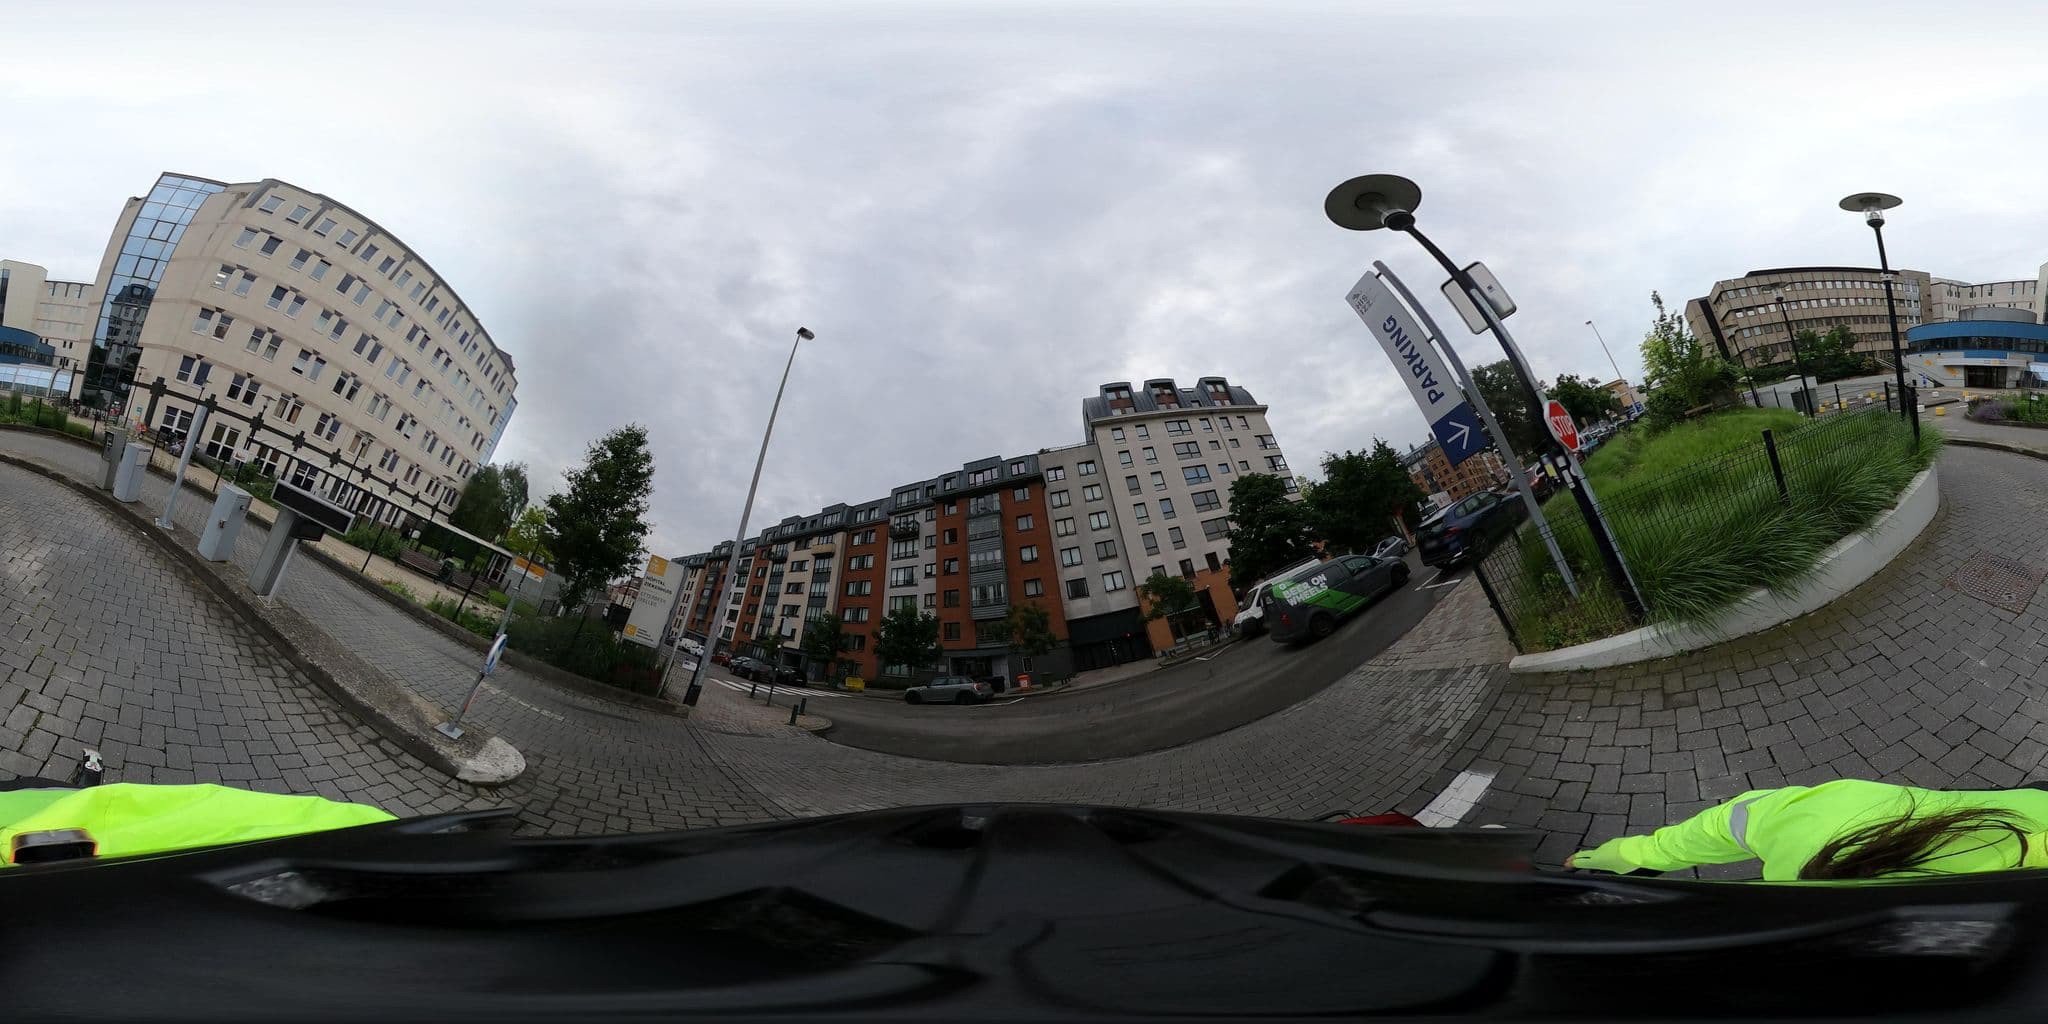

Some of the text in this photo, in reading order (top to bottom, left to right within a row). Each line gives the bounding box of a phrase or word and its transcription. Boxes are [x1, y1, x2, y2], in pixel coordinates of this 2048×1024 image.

[1383, 315, 1444, 405] PARKING
[1550, 415, 1575, 438] STOP
[1310, 573, 1328, 586] ON
[1286, 583, 1329, 607] WHEELS
